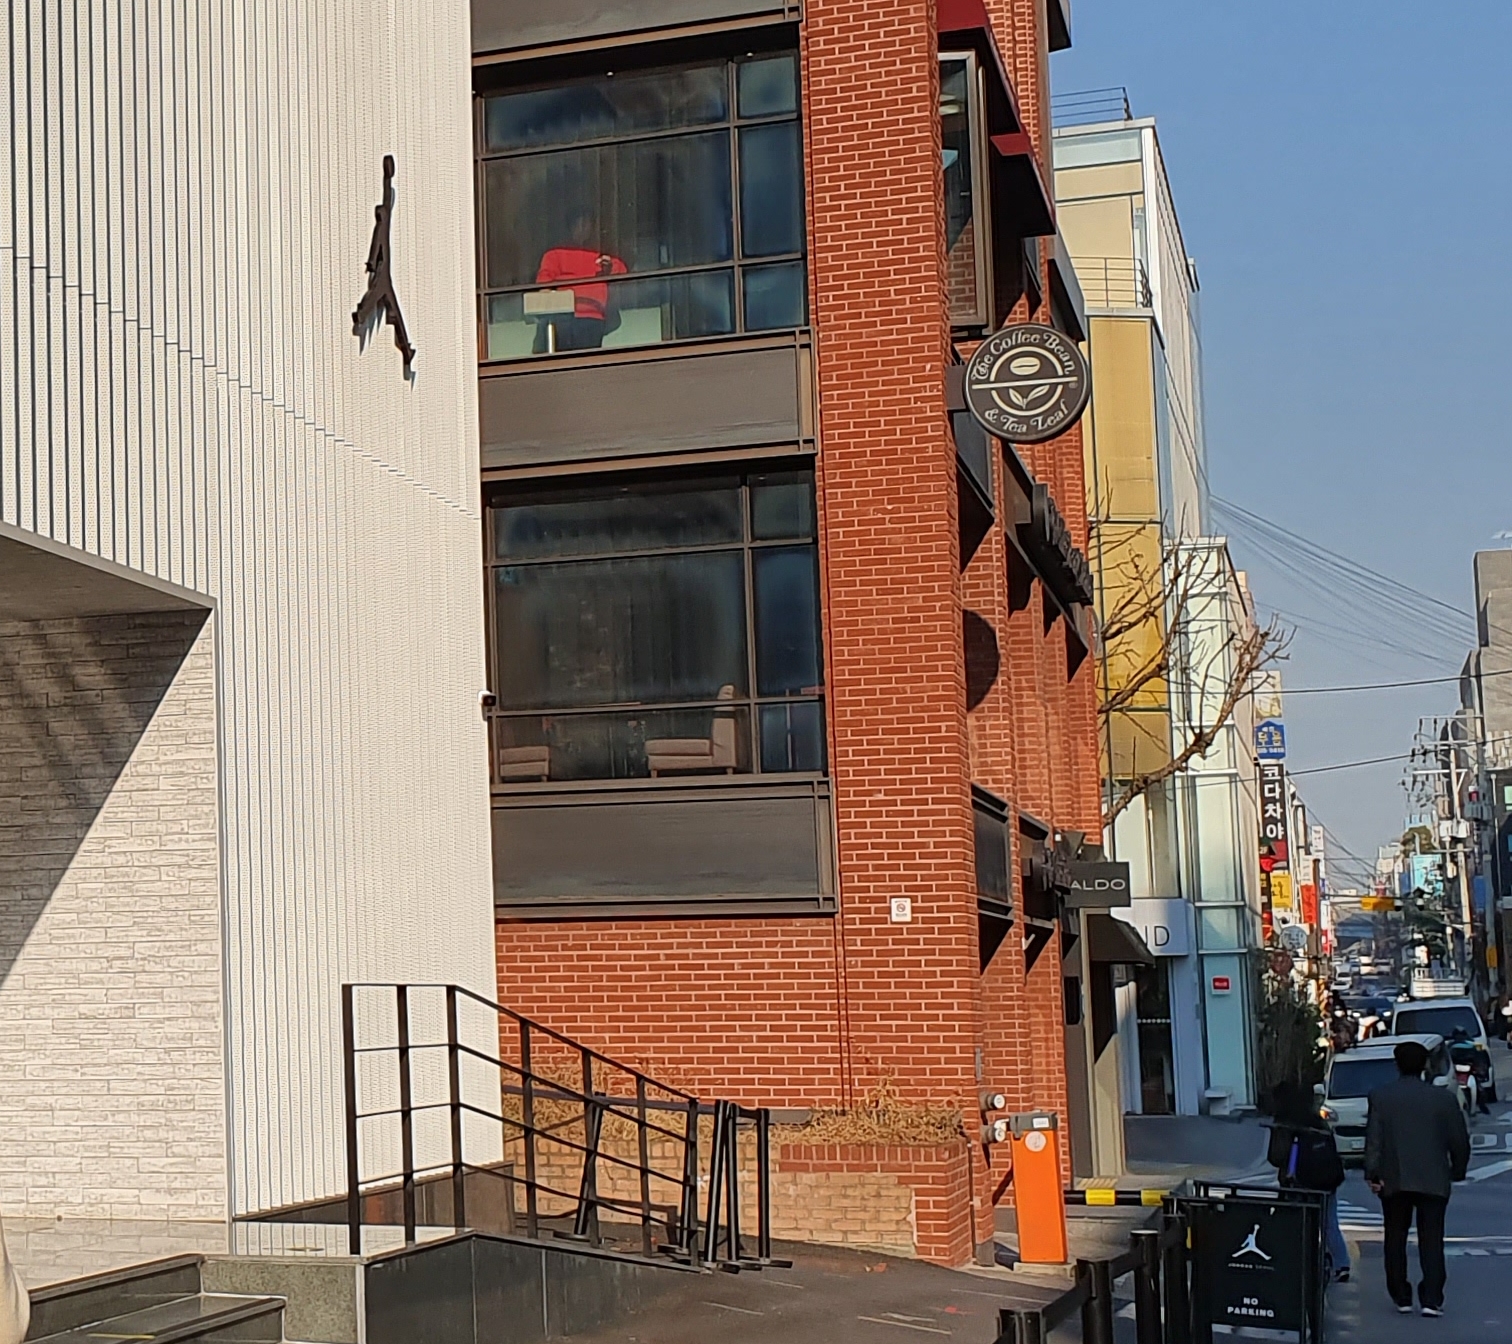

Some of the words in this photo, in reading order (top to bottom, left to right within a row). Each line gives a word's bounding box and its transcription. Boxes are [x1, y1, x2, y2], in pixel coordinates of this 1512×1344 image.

[971, 355, 993, 380] The
[990, 329, 1040, 355] Coffee
[1043, 332, 1076, 375] Bean
[985, 408, 999, 423] &
[1000, 414, 1028, 433] Tea
[1030, 398, 1069, 431] Leaf
[1262, 766, 1285, 840] 코다차야
[1070, 879, 1126, 890] ALDO
[1227, 1306, 1275, 1317] PARKING
[1243, 1297, 1258, 1305] NO
